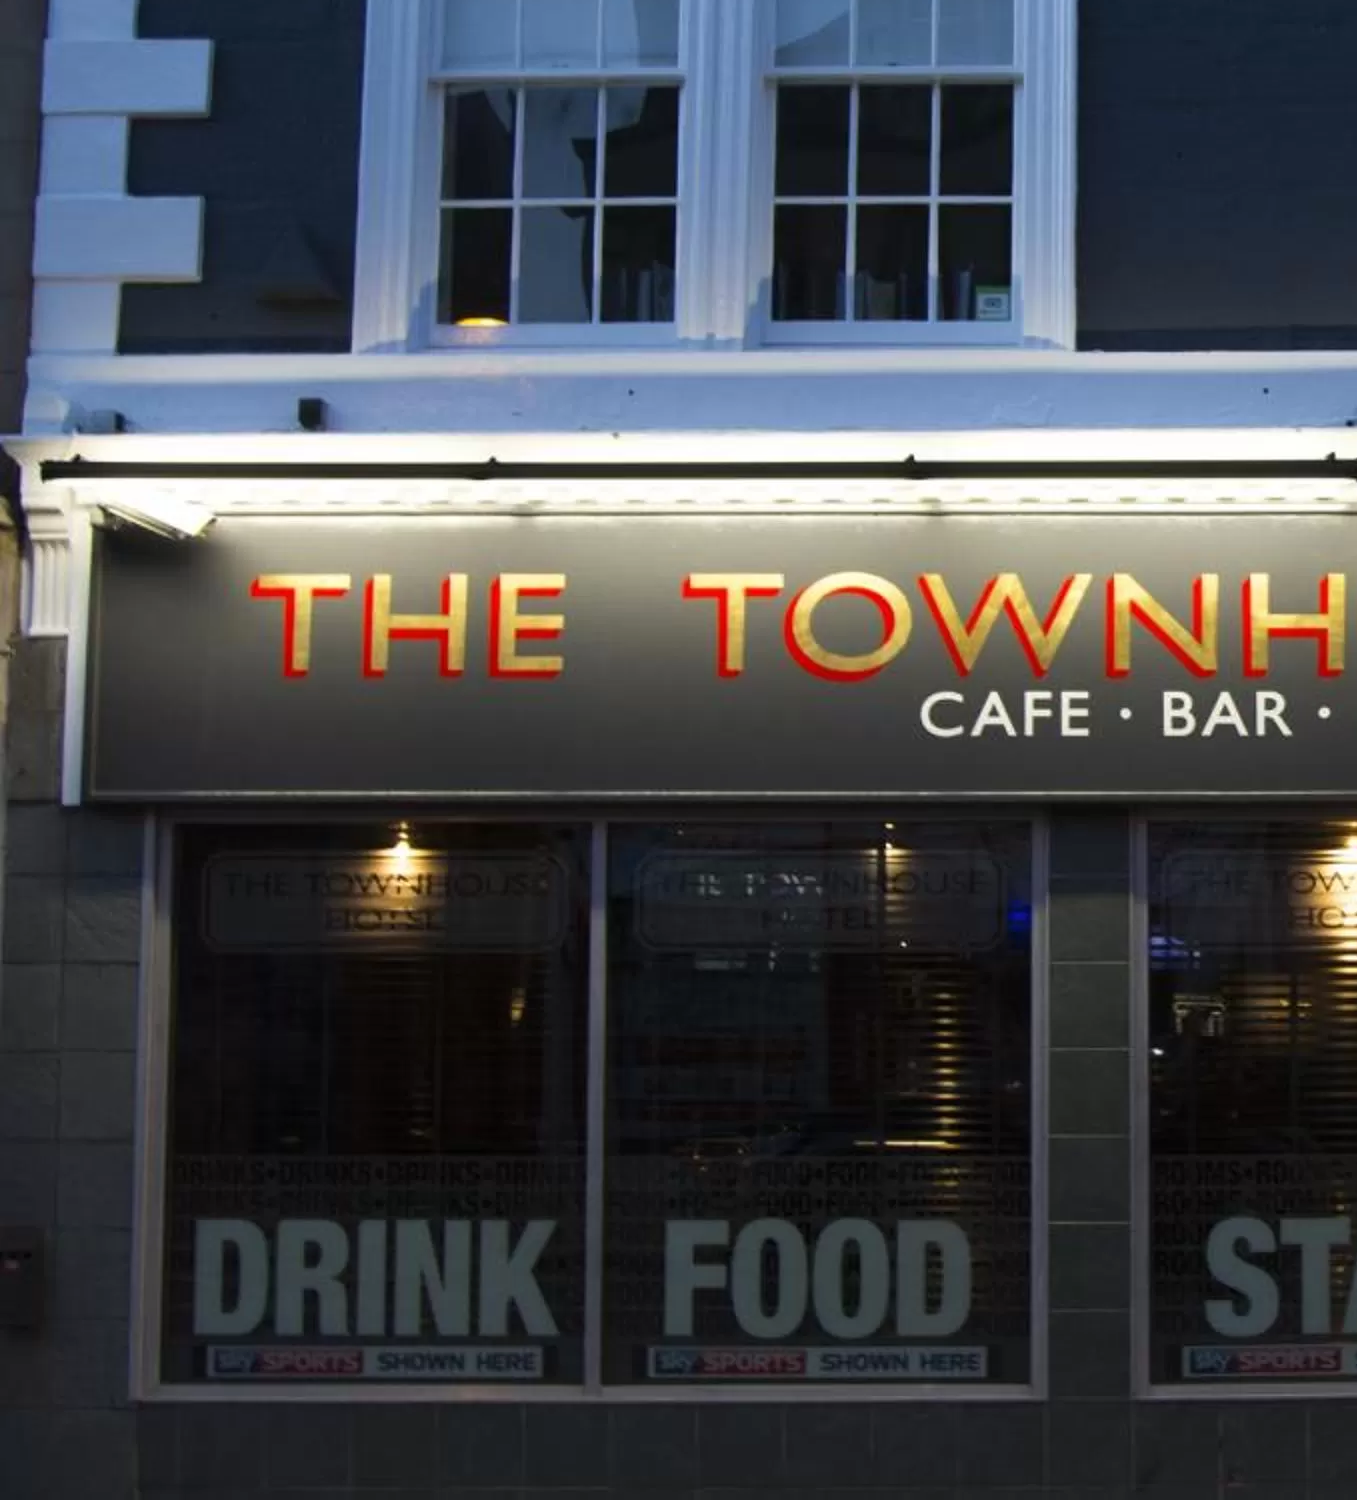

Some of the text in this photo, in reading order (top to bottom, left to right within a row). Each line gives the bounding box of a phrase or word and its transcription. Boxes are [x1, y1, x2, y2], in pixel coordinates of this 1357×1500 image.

[248, 572, 567, 678] THE
[919, 690, 1091, 738] CAFE
[1162, 690, 1294, 737] BAR
[193, 1219, 560, 1337] DRINK
[664, 1216, 972, 1339] FOOD
[263, 1351, 358, 1372] SPORTS
[377, 1352, 465, 1371] SHOWN
[476, 1352, 536, 1371] HERE
[703, 1351, 803, 1372] SPORTS
[819, 1352, 909, 1371] SHOWN
[919, 1352, 981, 1371] HERE
[1238, 1350, 1338, 1370] SPORTS
